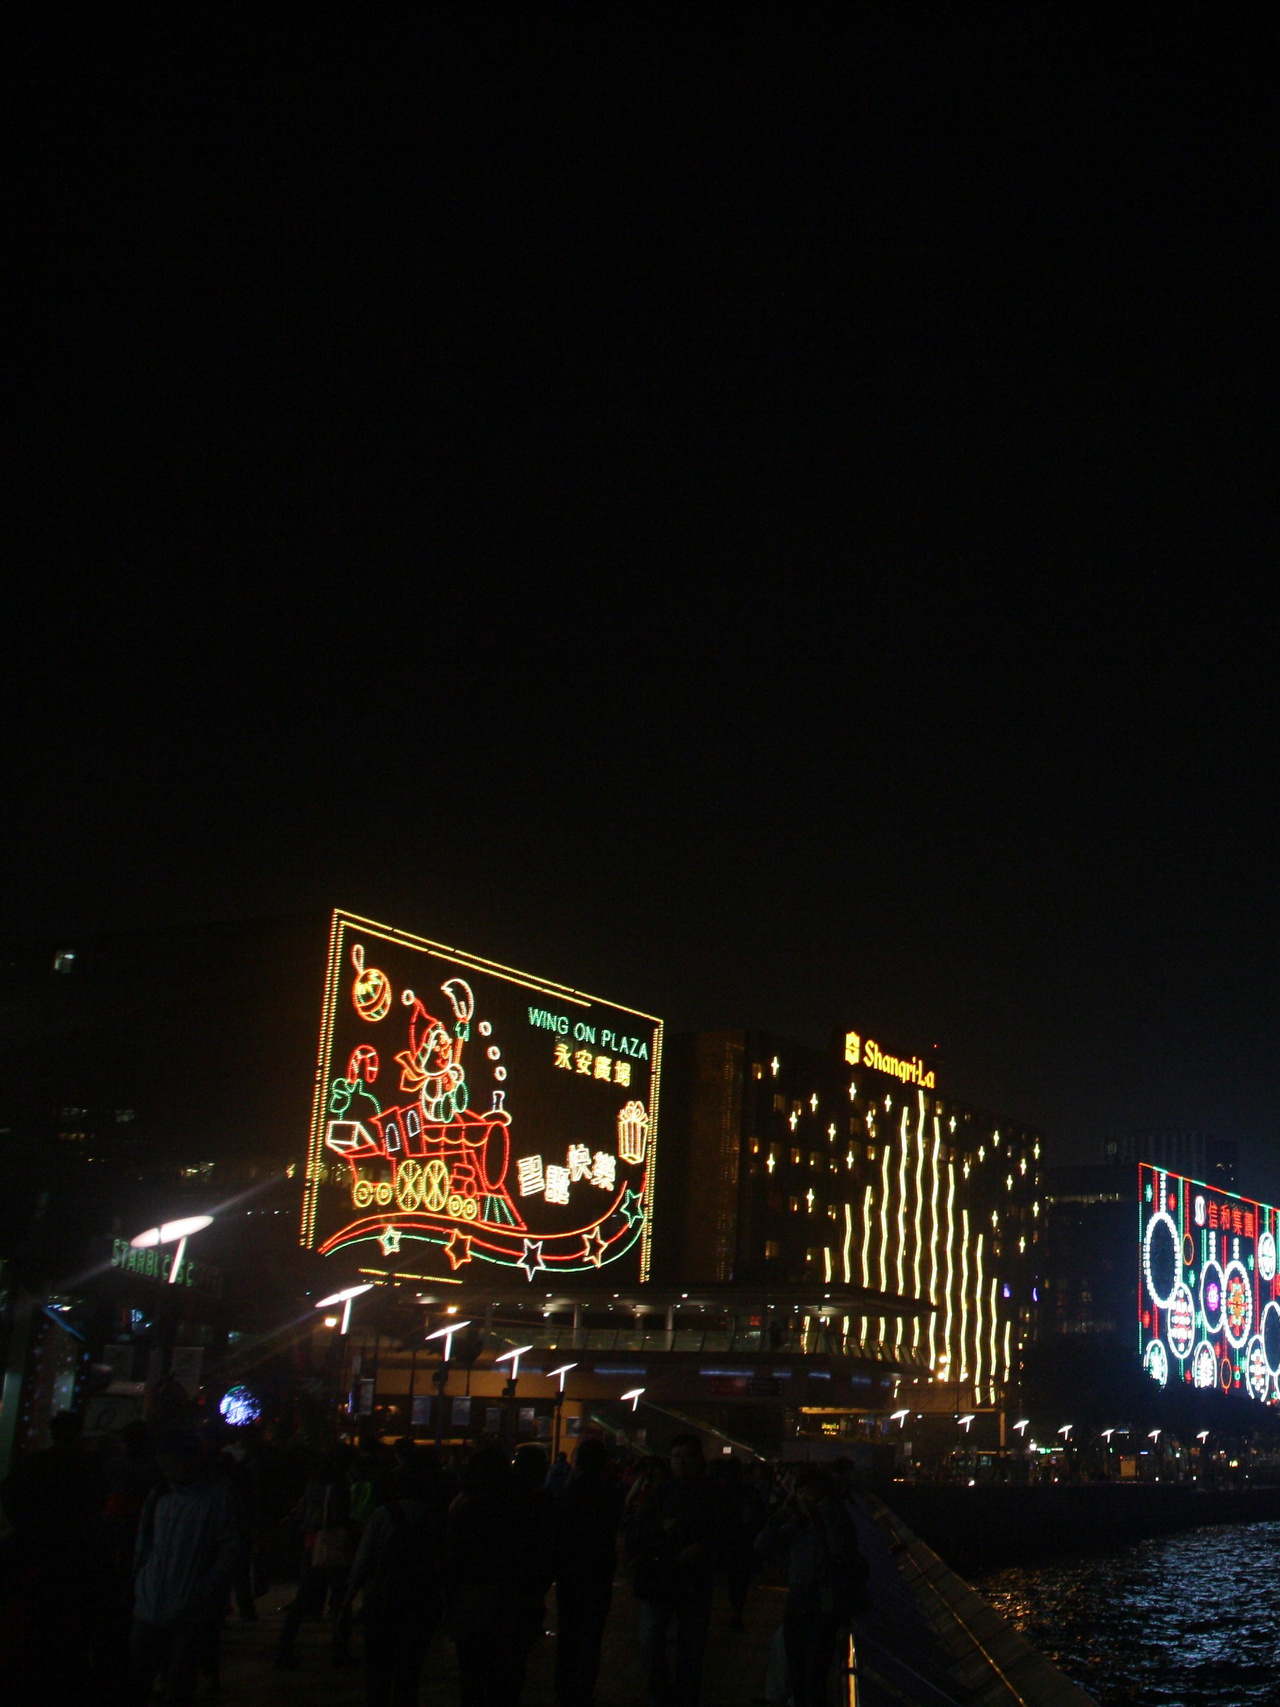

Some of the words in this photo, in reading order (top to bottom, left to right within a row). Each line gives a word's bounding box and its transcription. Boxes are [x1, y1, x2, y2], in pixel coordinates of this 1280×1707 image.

[528, 1006, 569, 1034] WING
[573, 1022, 596, 1044] ON
[601, 1029, 648, 1060] PLAZA
[554, 1043, 631, 1087] 永安廣場
[863, 1039, 935, 1088] Shangri-La
[111, 1238, 185, 1284] STARBCS
